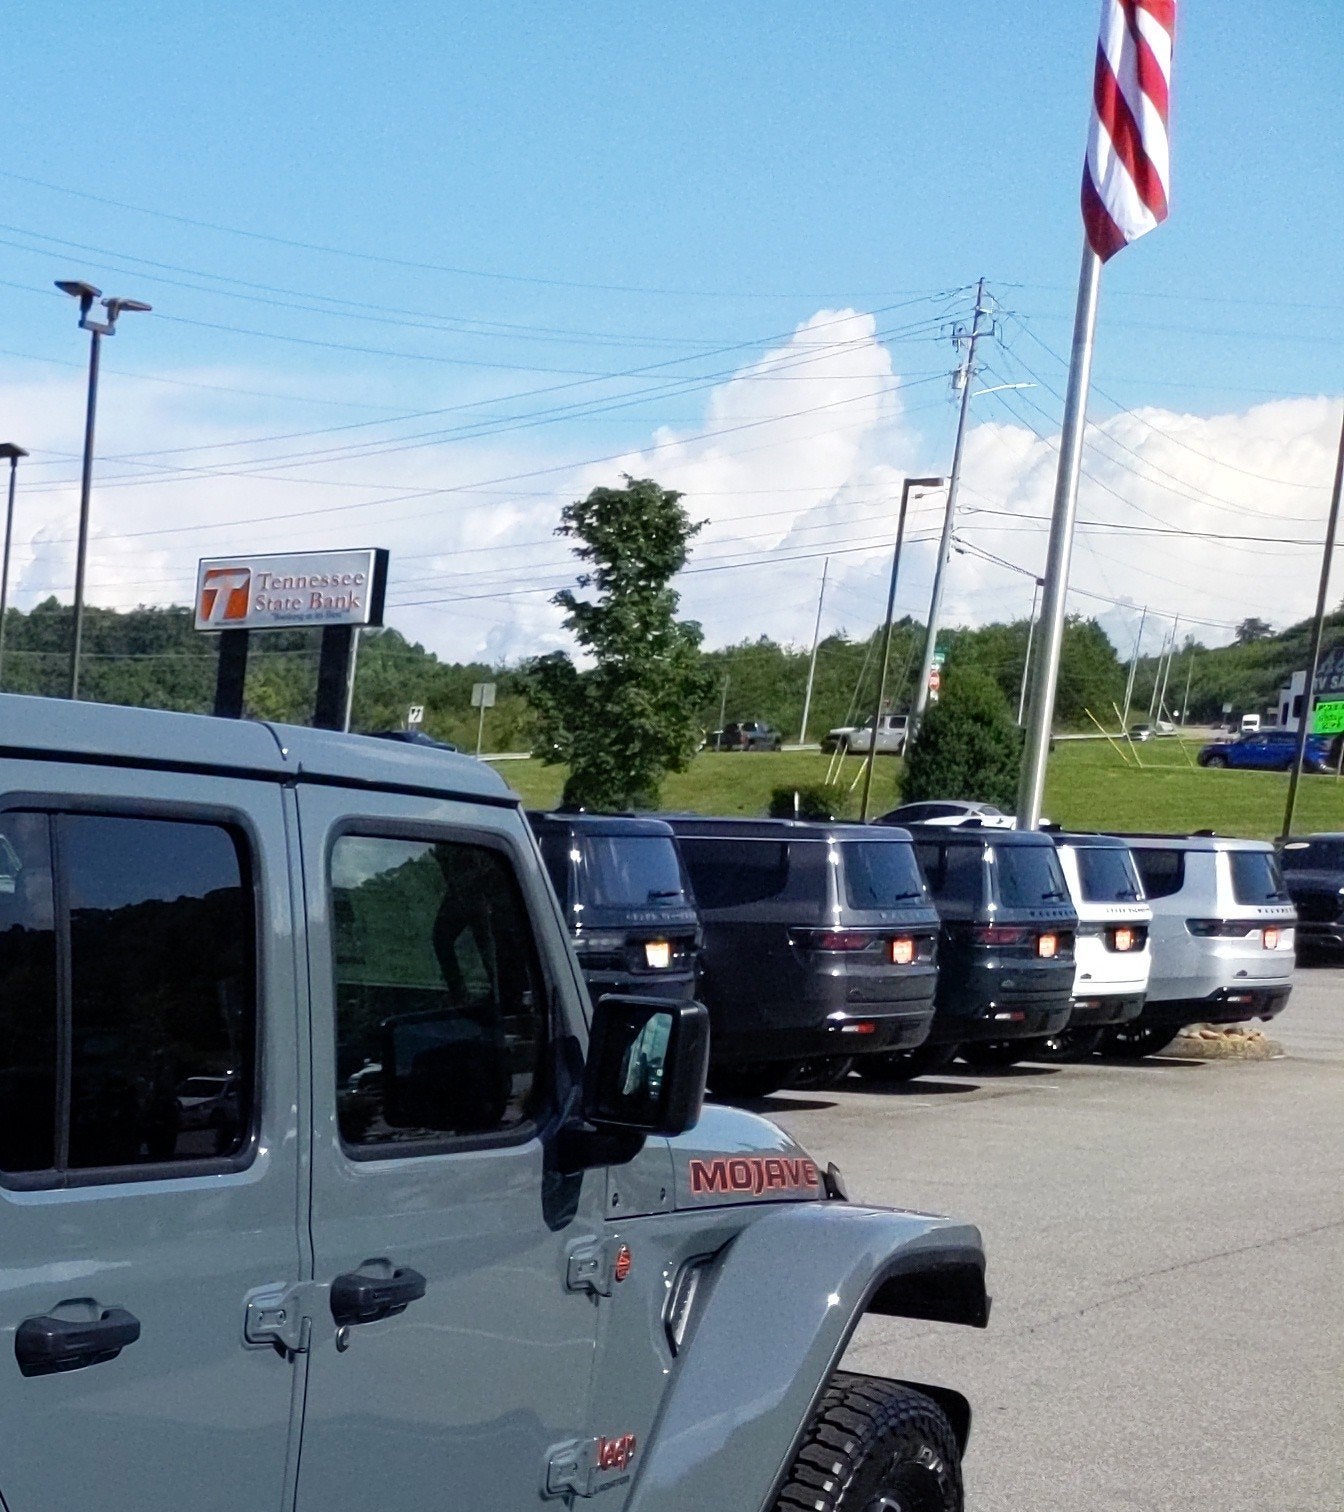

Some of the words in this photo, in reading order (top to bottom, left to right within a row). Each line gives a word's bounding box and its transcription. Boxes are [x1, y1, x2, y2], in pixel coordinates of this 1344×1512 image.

[257, 571, 365, 591] Tennessee
[255, 594, 303, 611] State
[310, 590, 361, 609] Bank
[690, 1158, 818, 1195] MOJAVE
